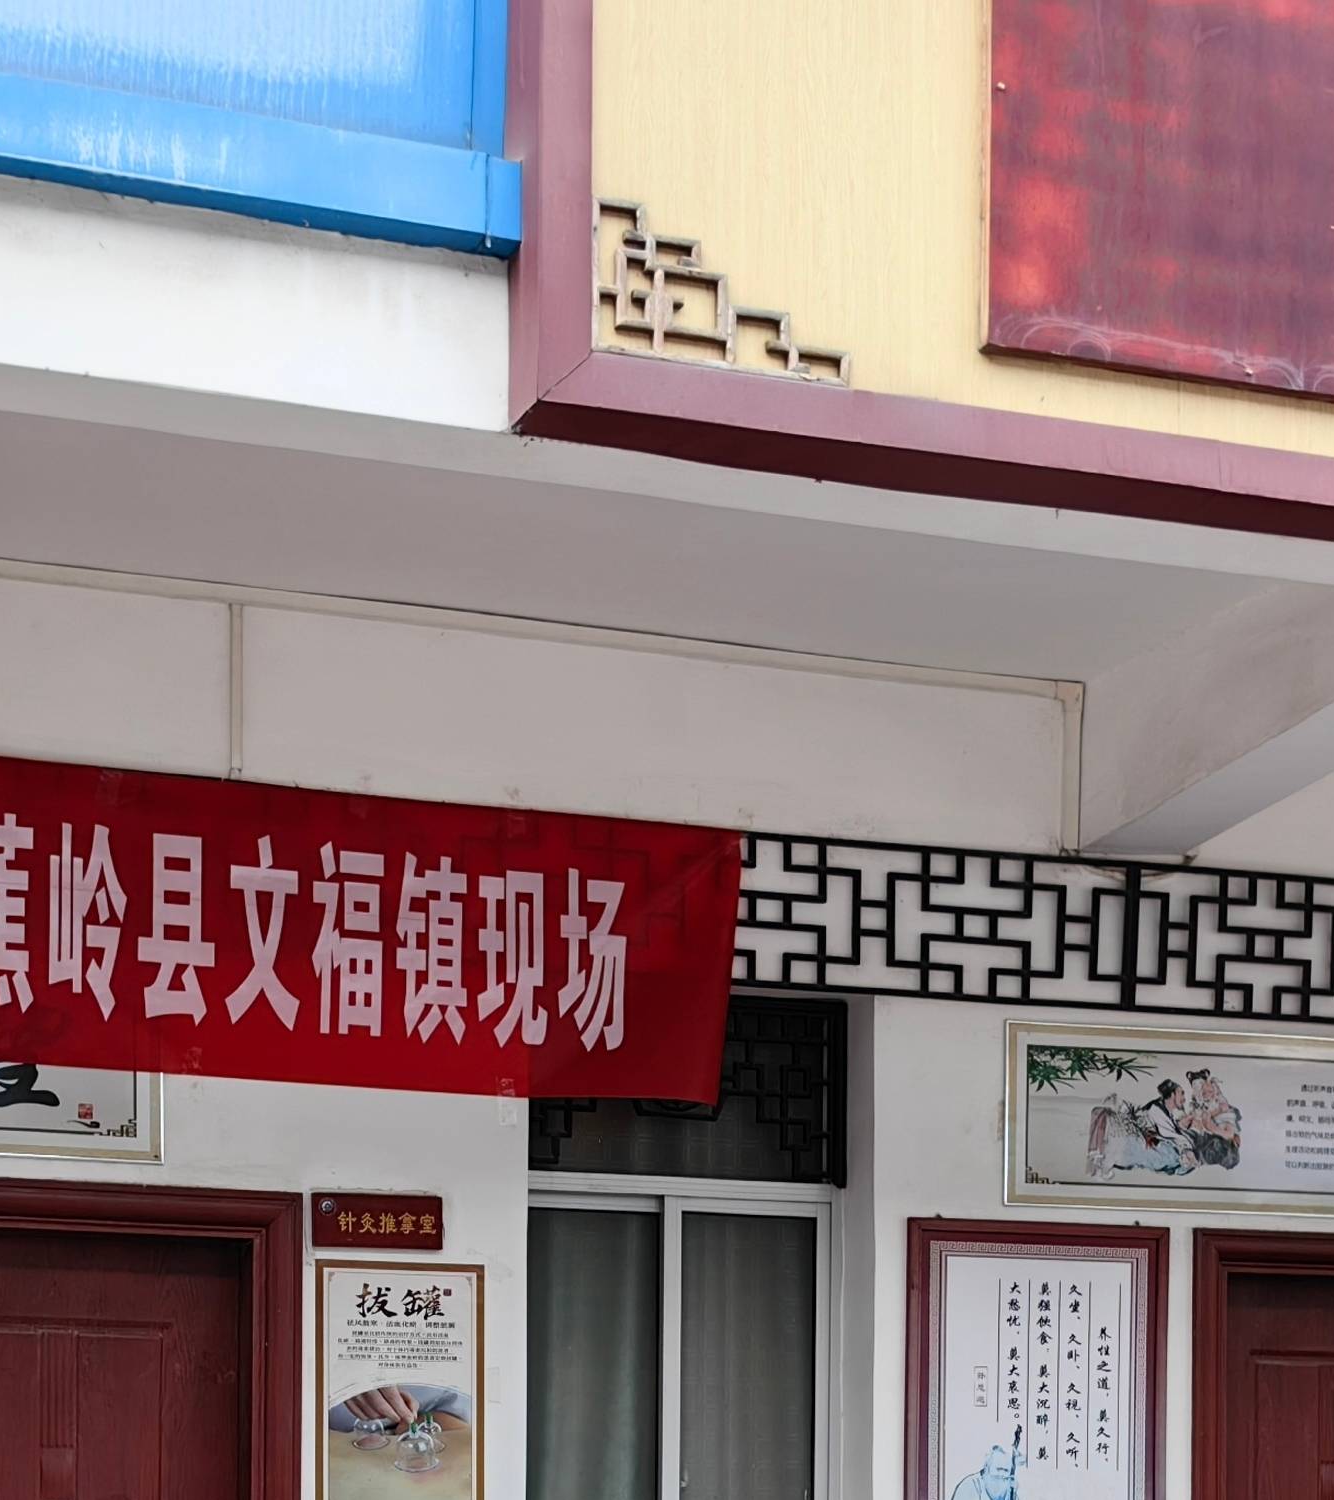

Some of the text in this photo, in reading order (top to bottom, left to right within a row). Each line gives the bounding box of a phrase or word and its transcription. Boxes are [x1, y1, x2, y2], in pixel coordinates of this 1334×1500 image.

[338, 1211, 438, 1236] 针灸推拿室
[355, 1283, 446, 1319] 拔罐
